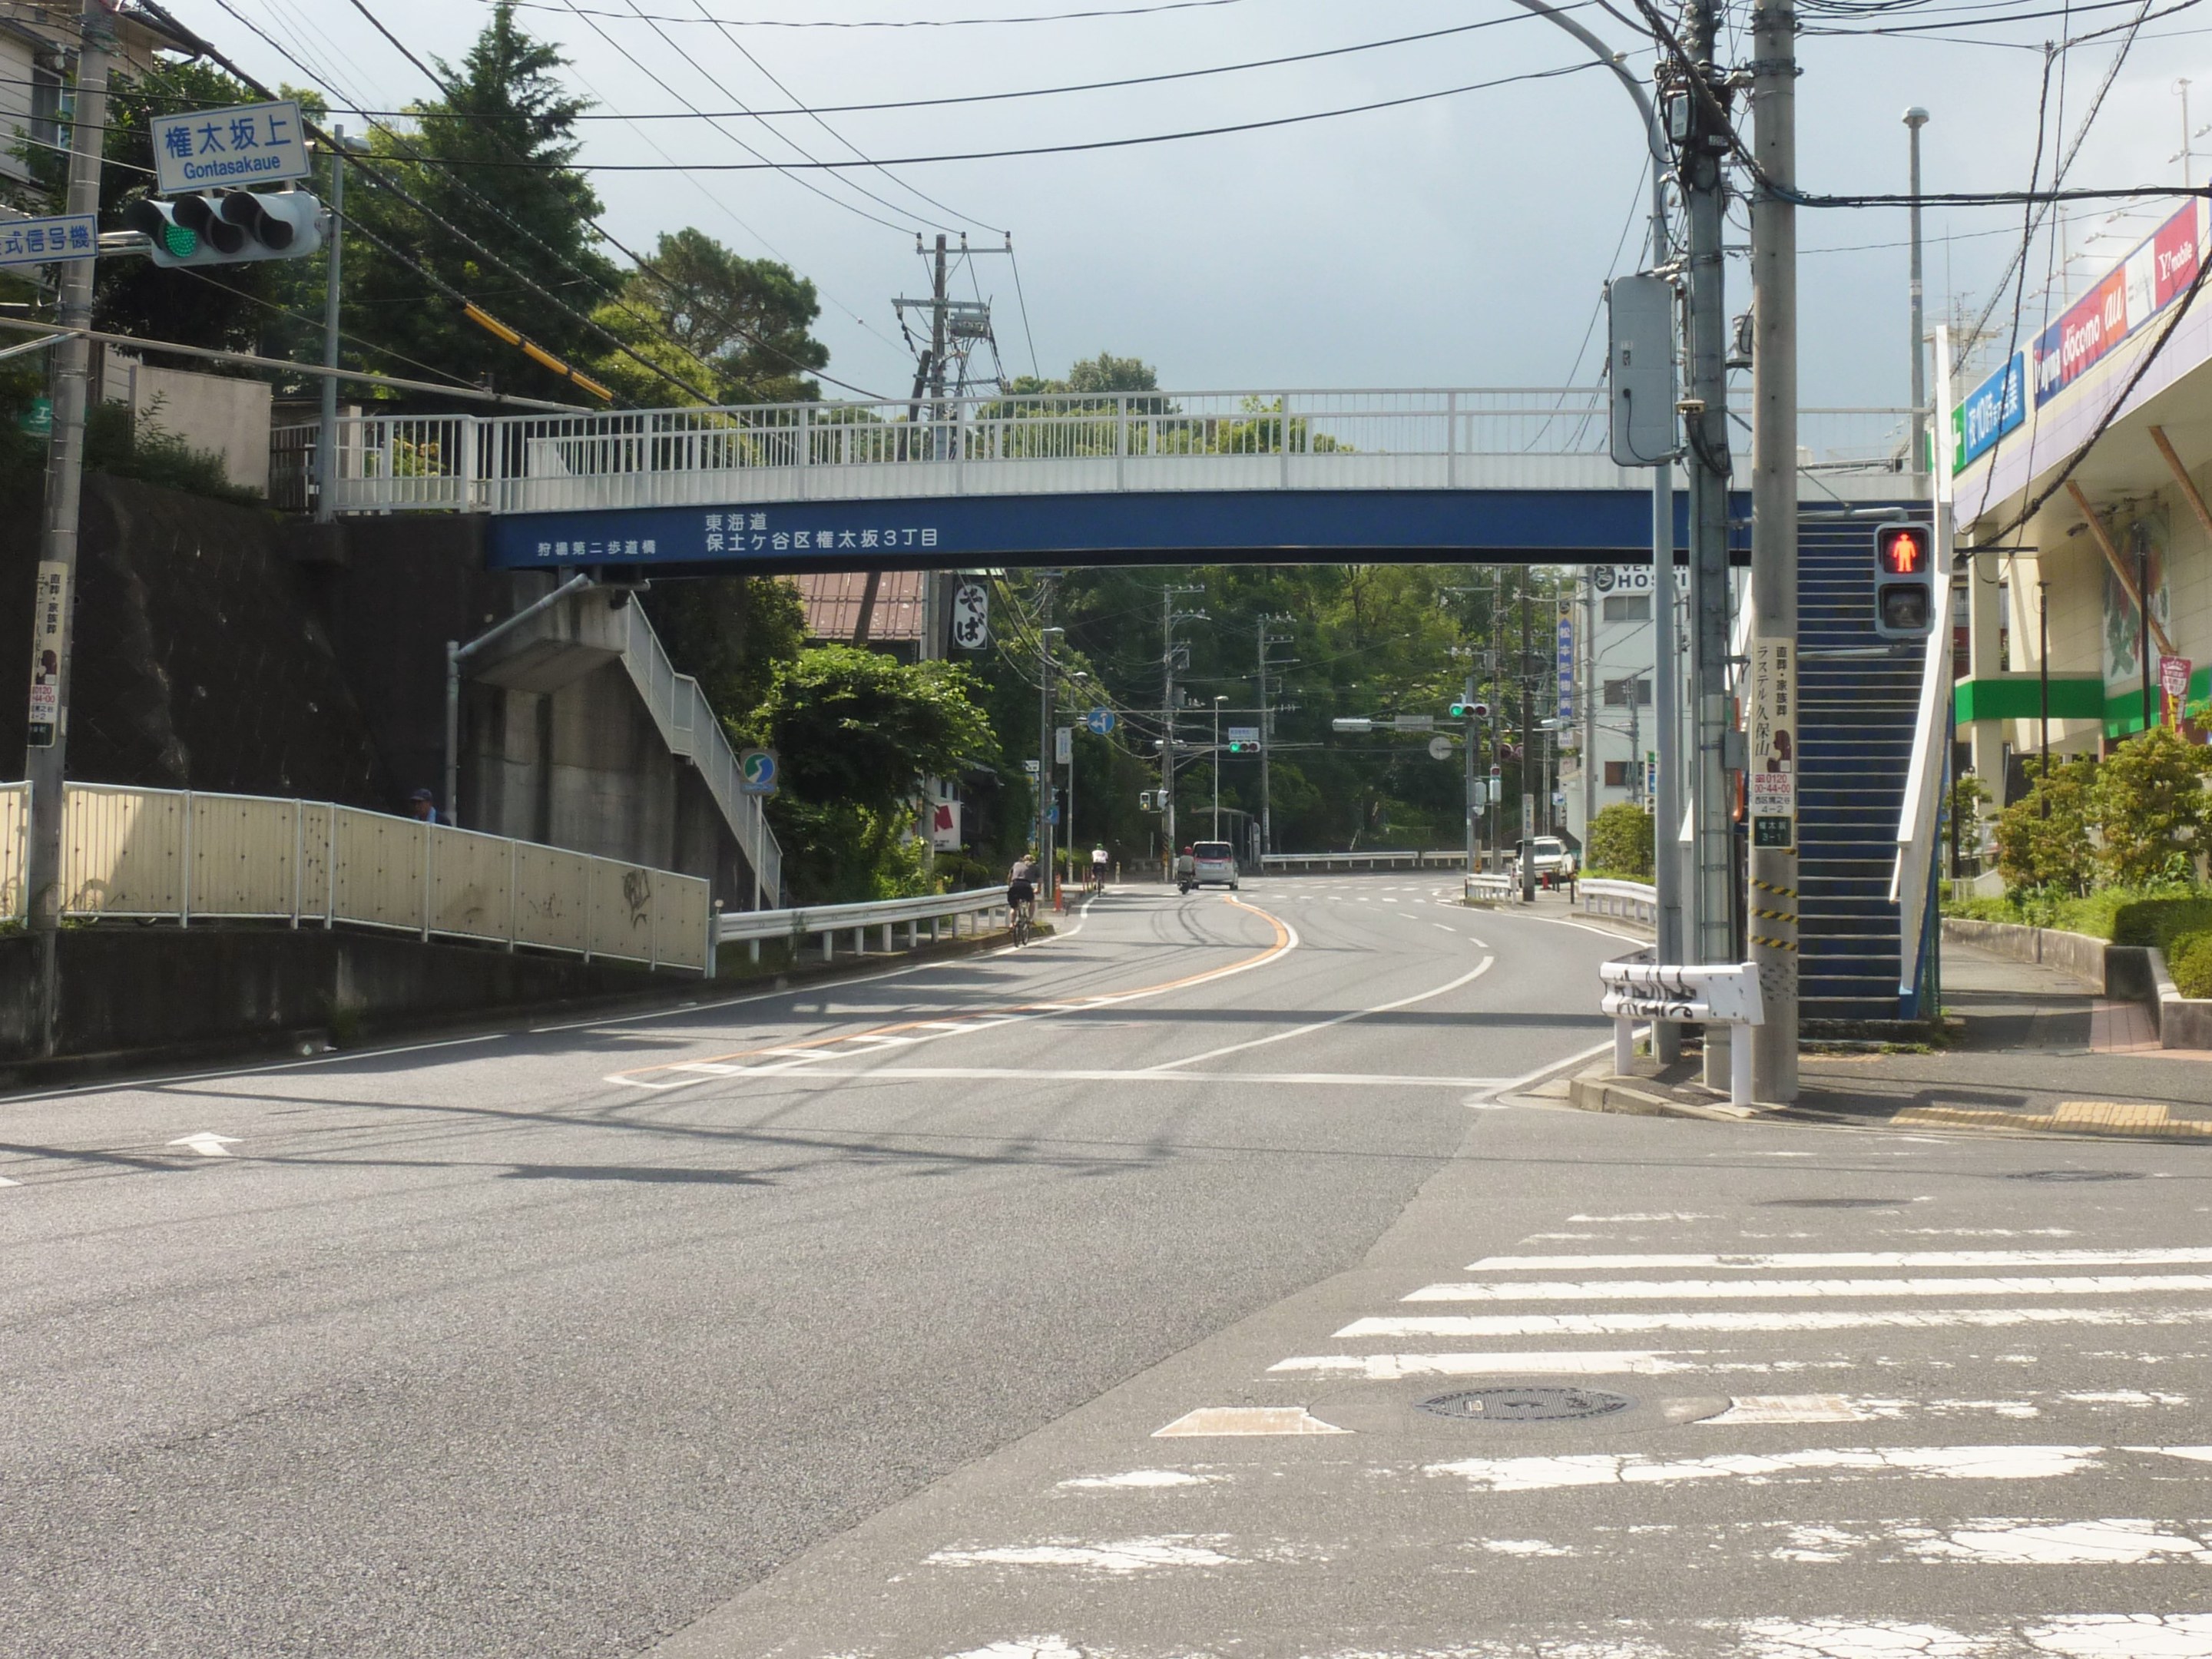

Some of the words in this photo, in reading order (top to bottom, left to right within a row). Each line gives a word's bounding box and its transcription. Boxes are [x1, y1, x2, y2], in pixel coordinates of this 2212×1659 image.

[165, 114, 292, 159] 権太坂上
[184, 155, 281, 180] Gontasakaue
[0, 225, 89, 255] 式信号機
[2104, 286, 2123, 332] au
[2063, 314, 2100, 366] docomo
[705, 512, 767, 532] 東海道
[956, 588, 985, 642] そば
[1755, 646, 1770, 757] ラステル久保山
[1754, 784, 1791, 793] 00-44-00
[1767, 774, 1787, 783] 0120
